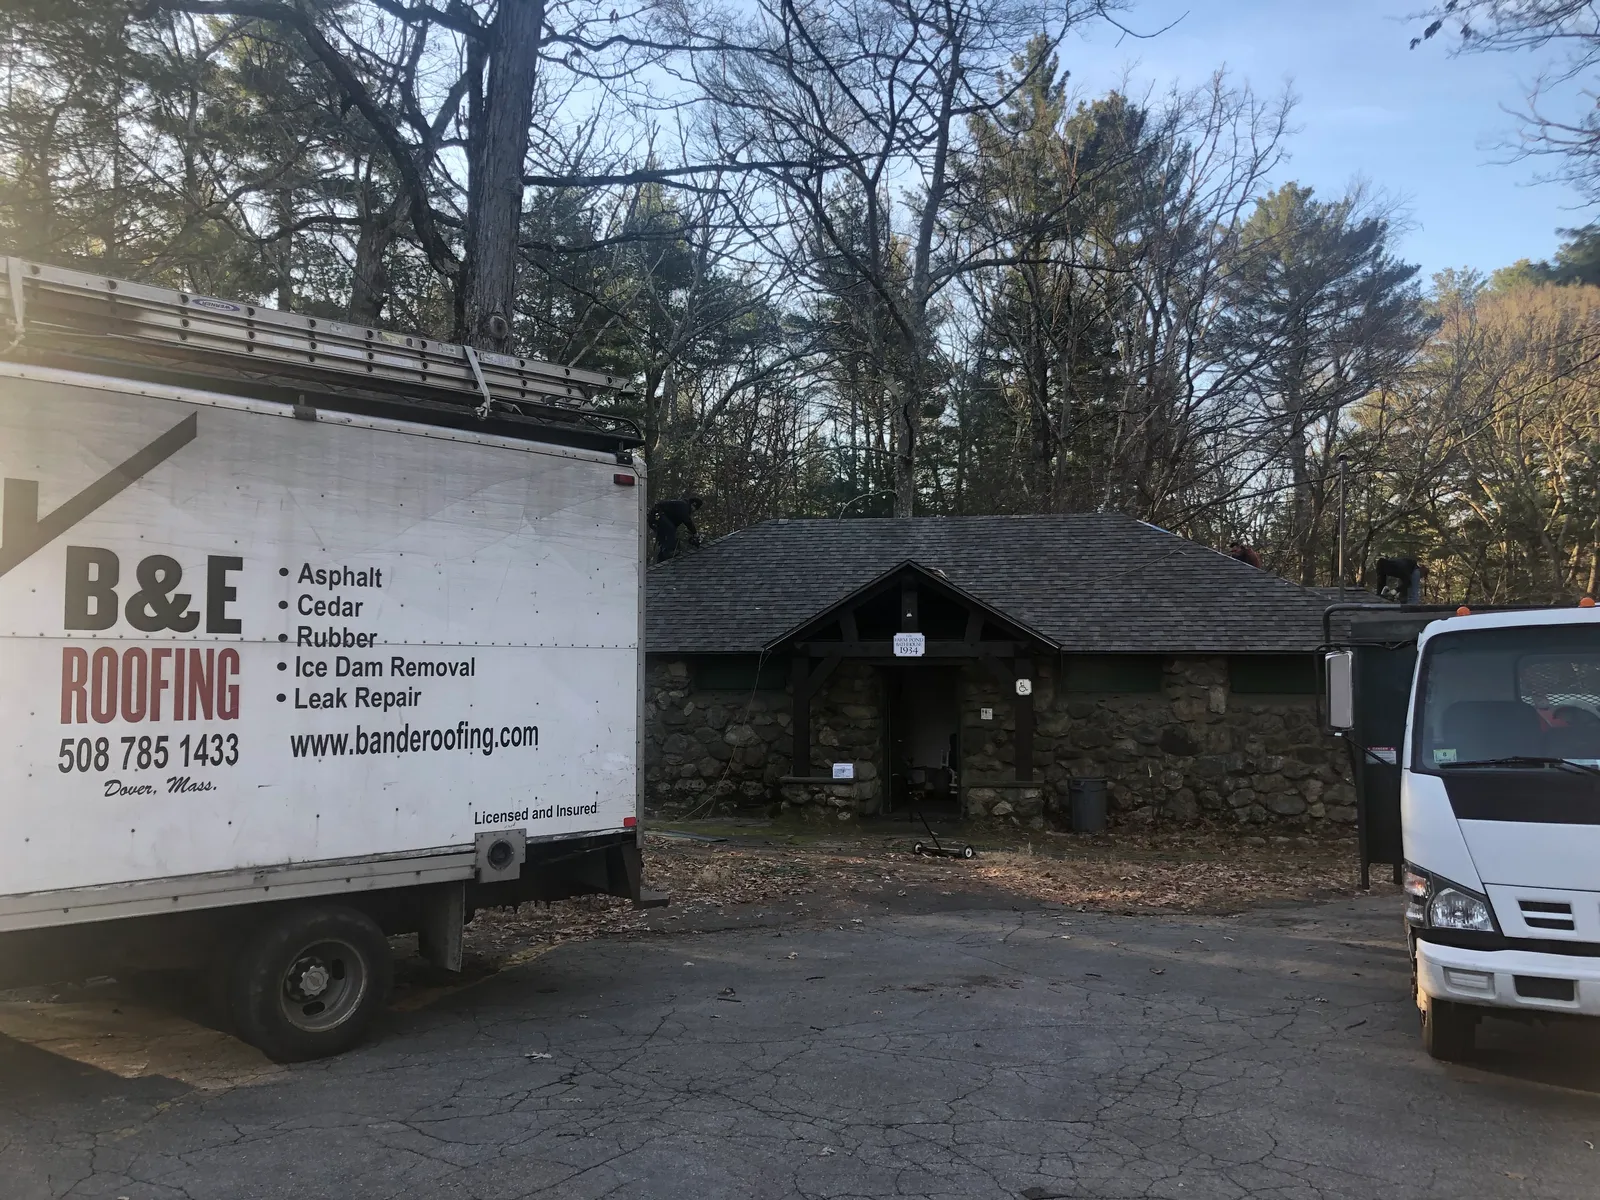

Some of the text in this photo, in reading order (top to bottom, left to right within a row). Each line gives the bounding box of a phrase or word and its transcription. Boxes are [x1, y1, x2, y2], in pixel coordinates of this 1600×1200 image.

[297, 562, 383, 590] Asphalt
[64, 545, 243, 634] B&E
[297, 594, 364, 617] Cedar
[297, 625, 378, 648] Rubber
[295, 656, 475, 677] Ice Dam Removal
[60, 646, 240, 724] ROOFING
[294, 686, 422, 712] Leak Repair
[290, 721, 539, 757] www.banderoofing.com
[58, 733, 239, 773] 508 785 1433
[104, 776, 217, 797] Dover, Mass.
[474, 802, 597, 825] Licensed and Insured
